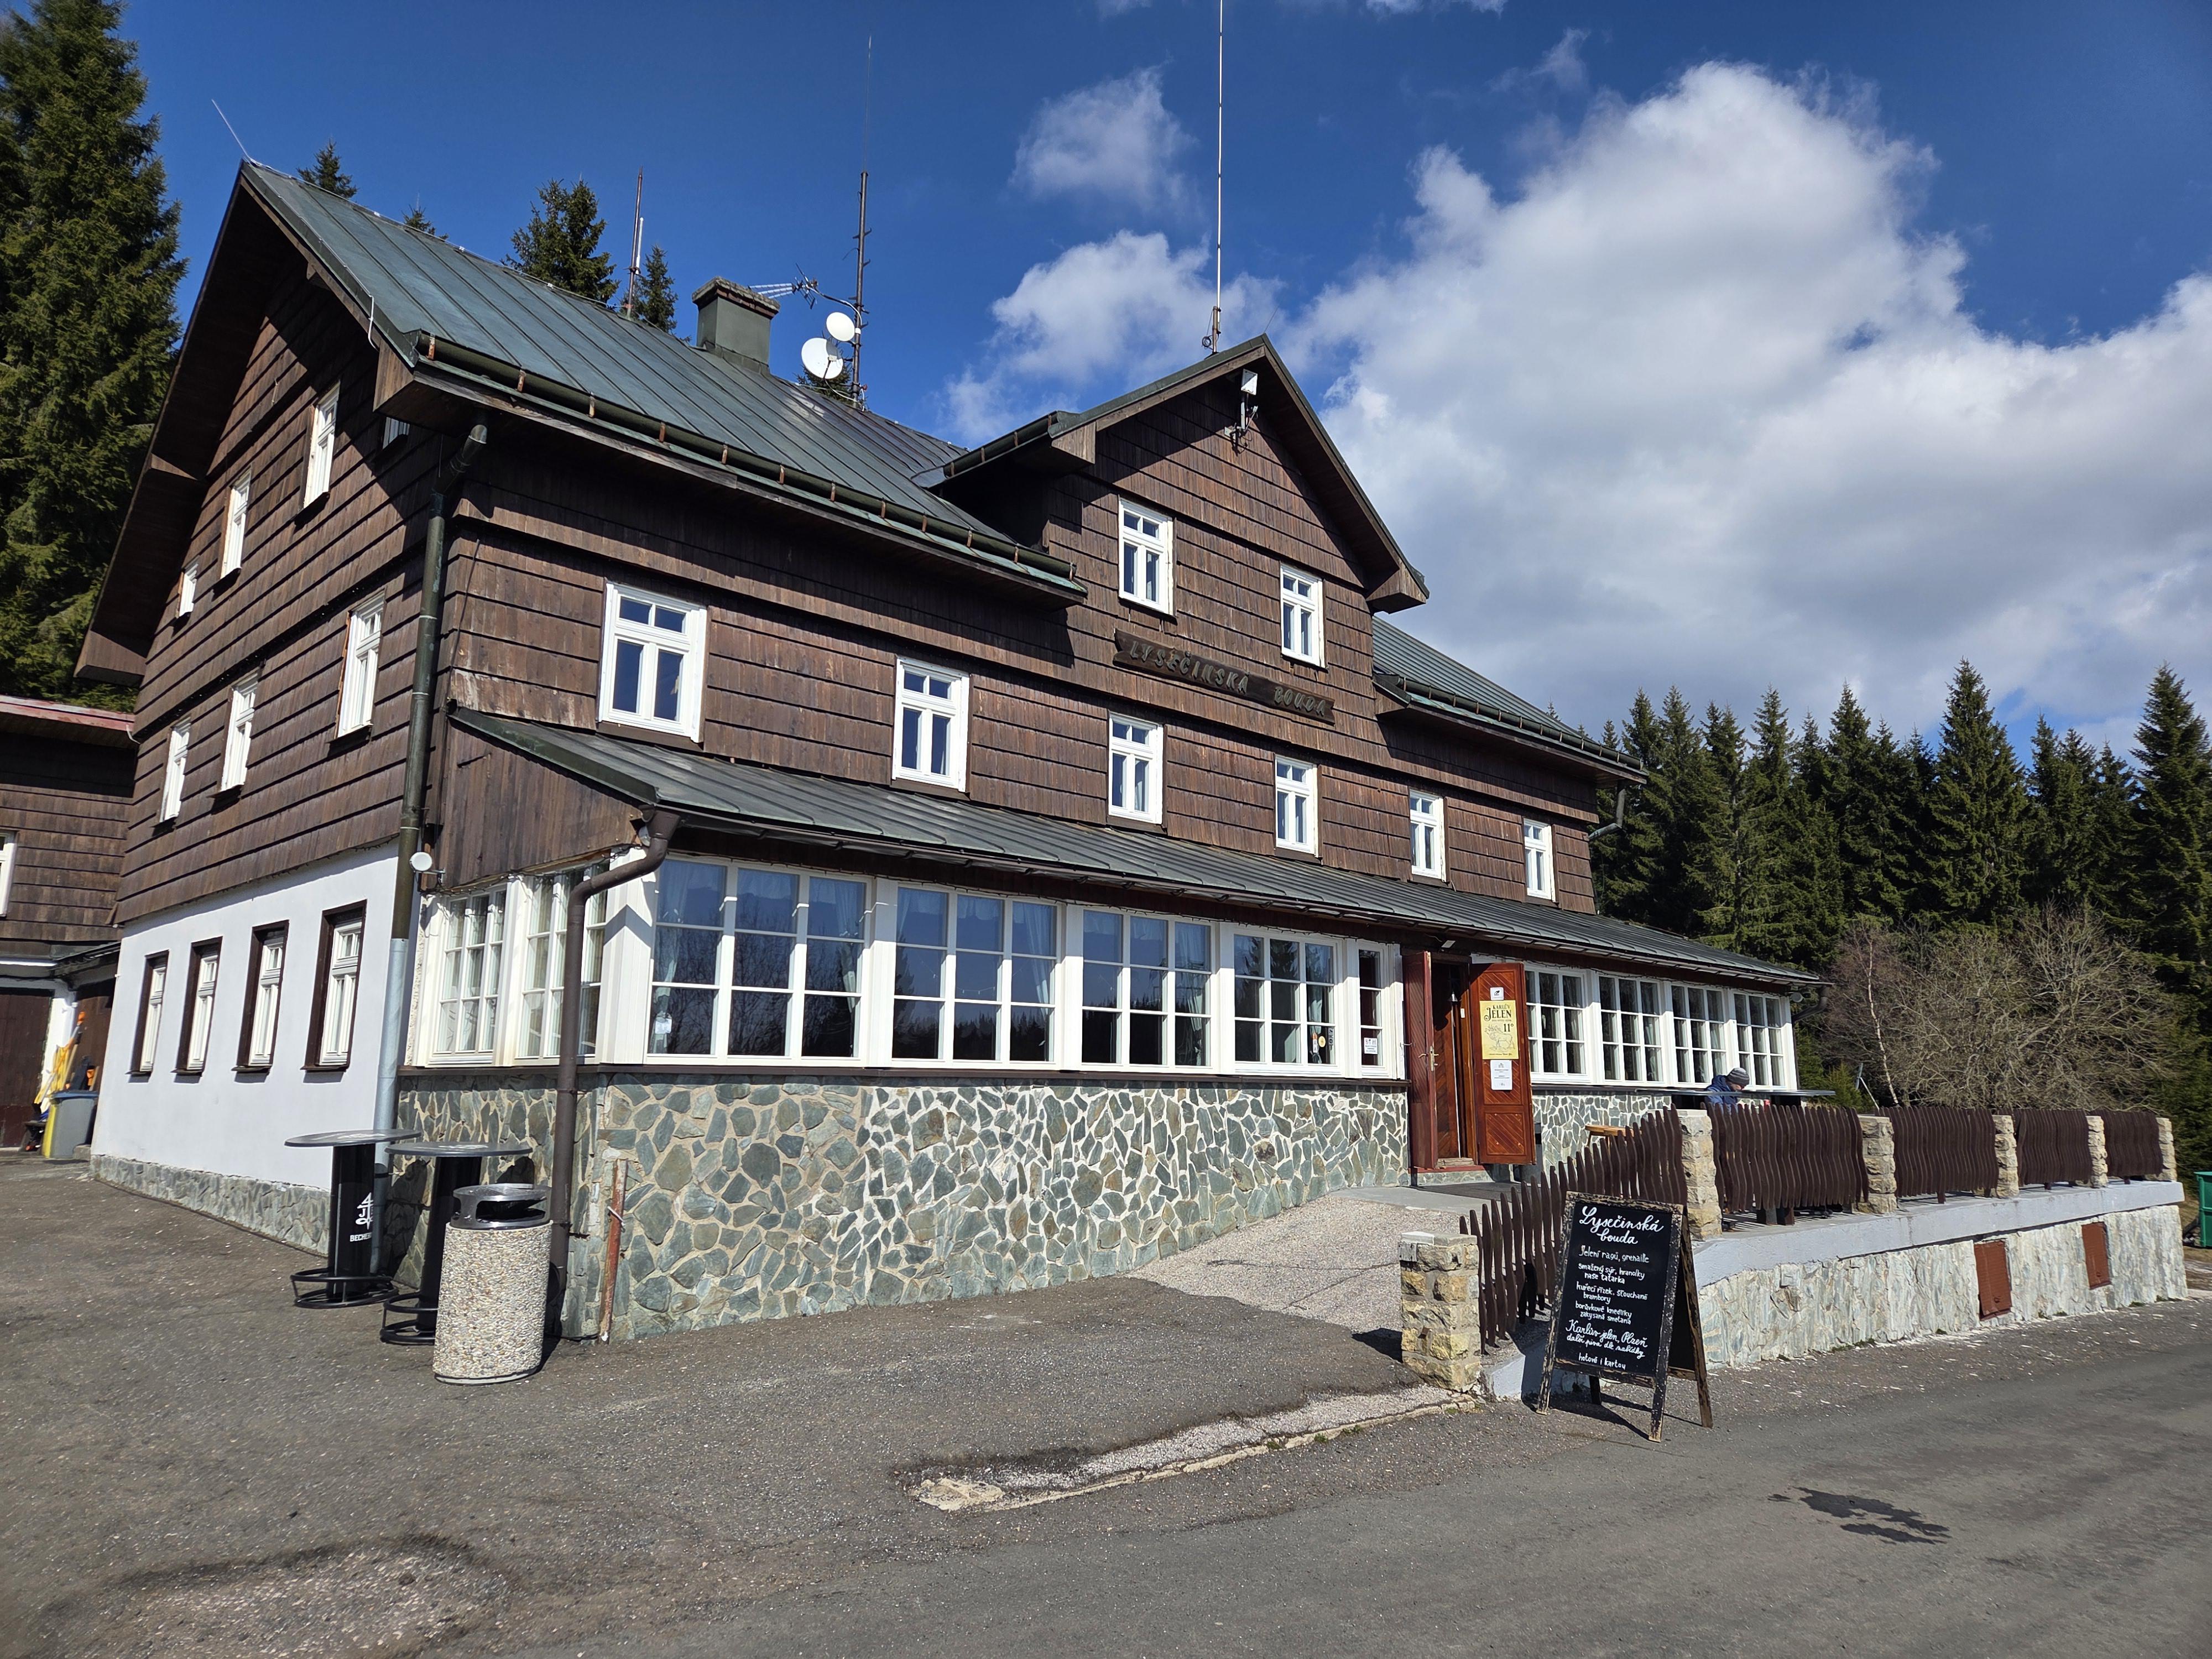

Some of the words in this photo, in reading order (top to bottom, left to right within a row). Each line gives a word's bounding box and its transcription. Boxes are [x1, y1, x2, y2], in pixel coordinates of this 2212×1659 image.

[1130, 641, 1251, 694] LYSEČINSKÁ
[1274, 686, 1326, 717] BOUDA
[1484, 1007, 1511, 1022] JELEN
[1504, 1023, 1514, 1032] 11°
[1579, 1206, 1664, 1233] Lysečinská
[1597, 1228, 1639, 1244] bouda
[1579, 1245, 1601, 1258] Jelení
[1622, 1253, 1650, 1263] grenaille
[1578, 1263, 1604, 1274] smažený
[1619, 1267, 1645, 1281] hranolky
[1576, 1281, 1597, 1292] kuřecí
[1583, 1291, 1611, 1305] brambory
[1607, 1316, 1631, 1325] smetana
[1621, 1332, 1648, 1347] Plzeň
[1585, 1339, 1601, 1348] piva
[1615, 1345, 1646, 1359] nabídky
[1579, 1352, 1598, 1364] hotově
[1604, 1357, 1626, 1370] kartou
